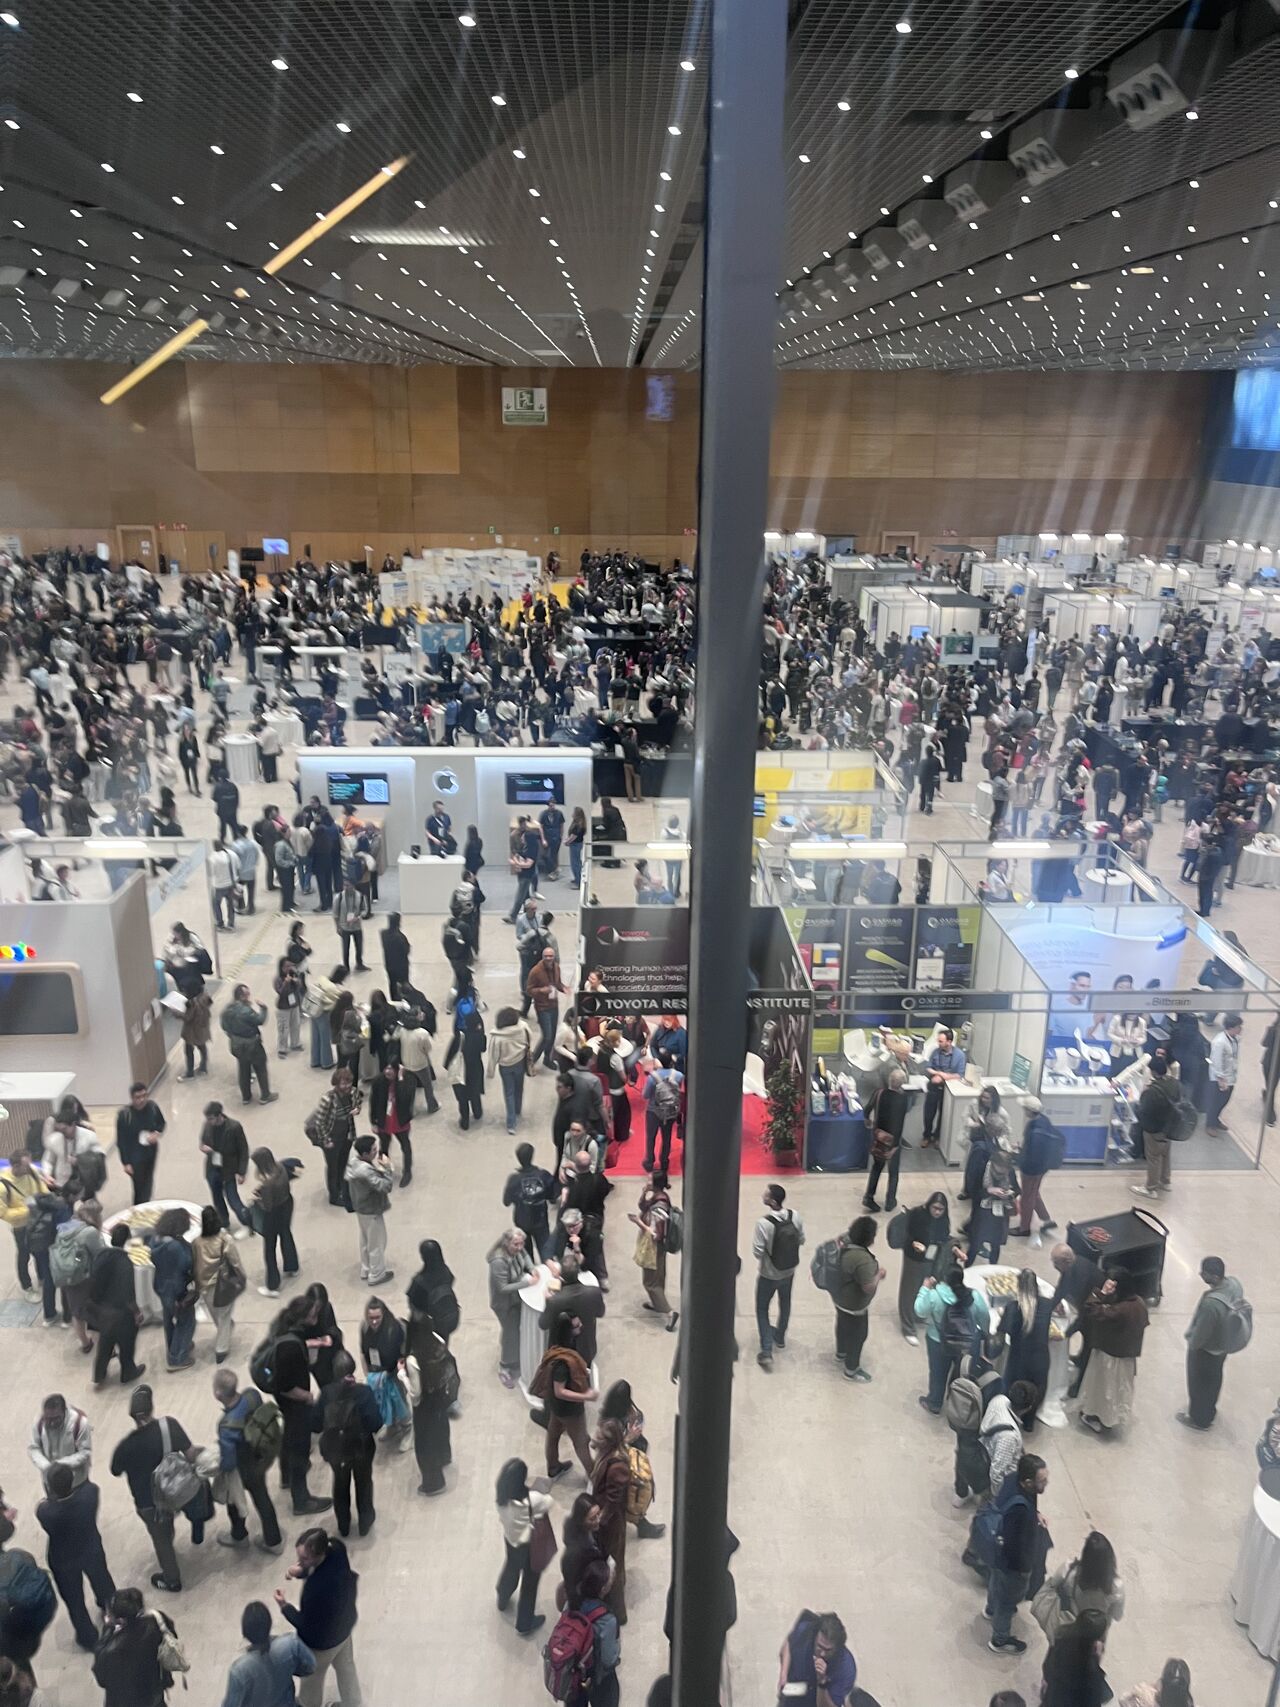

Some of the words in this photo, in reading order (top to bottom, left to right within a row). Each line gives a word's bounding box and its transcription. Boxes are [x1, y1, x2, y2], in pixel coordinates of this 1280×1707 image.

[605, 999, 659, 1010] TOYOTA
[662, 998, 687, 1010] RES
[746, 998, 811, 1008] NSTITUTE
